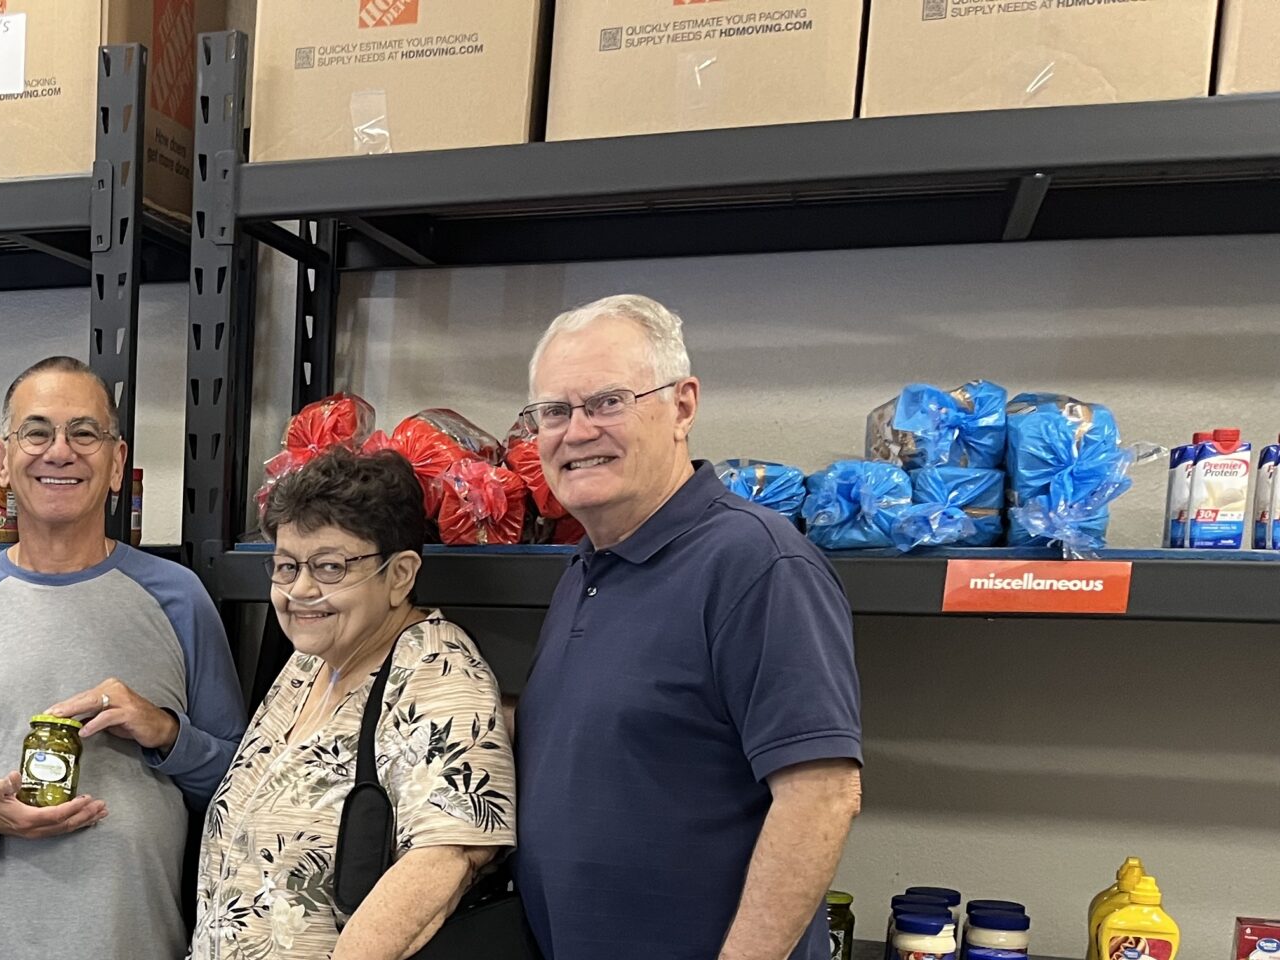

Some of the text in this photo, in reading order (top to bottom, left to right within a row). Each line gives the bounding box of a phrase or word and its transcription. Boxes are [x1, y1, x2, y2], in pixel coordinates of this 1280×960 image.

[359, 0, 395, 28] HO
[950, 4, 996, 18] SUPPLY
[997, 0, 1037, 13] NEEDS
[626, 8, 807, 36] QUICKLY ESTIMATE YOUR PACKING
[318, 33, 478, 56] QUICKLY ESTIMATE YOUR PACKING
[625, 20, 813, 49] SUPPLY NEEDS AT HDMOVING.COM
[318, 44, 484, 67] SUPPLY NEEDS AT HDMOVING.COM
[1203, 461, 1242, 470] Premier
[1204, 469, 1239, 477] Protein
[970, 573, 1104, 592] miscellaneous
